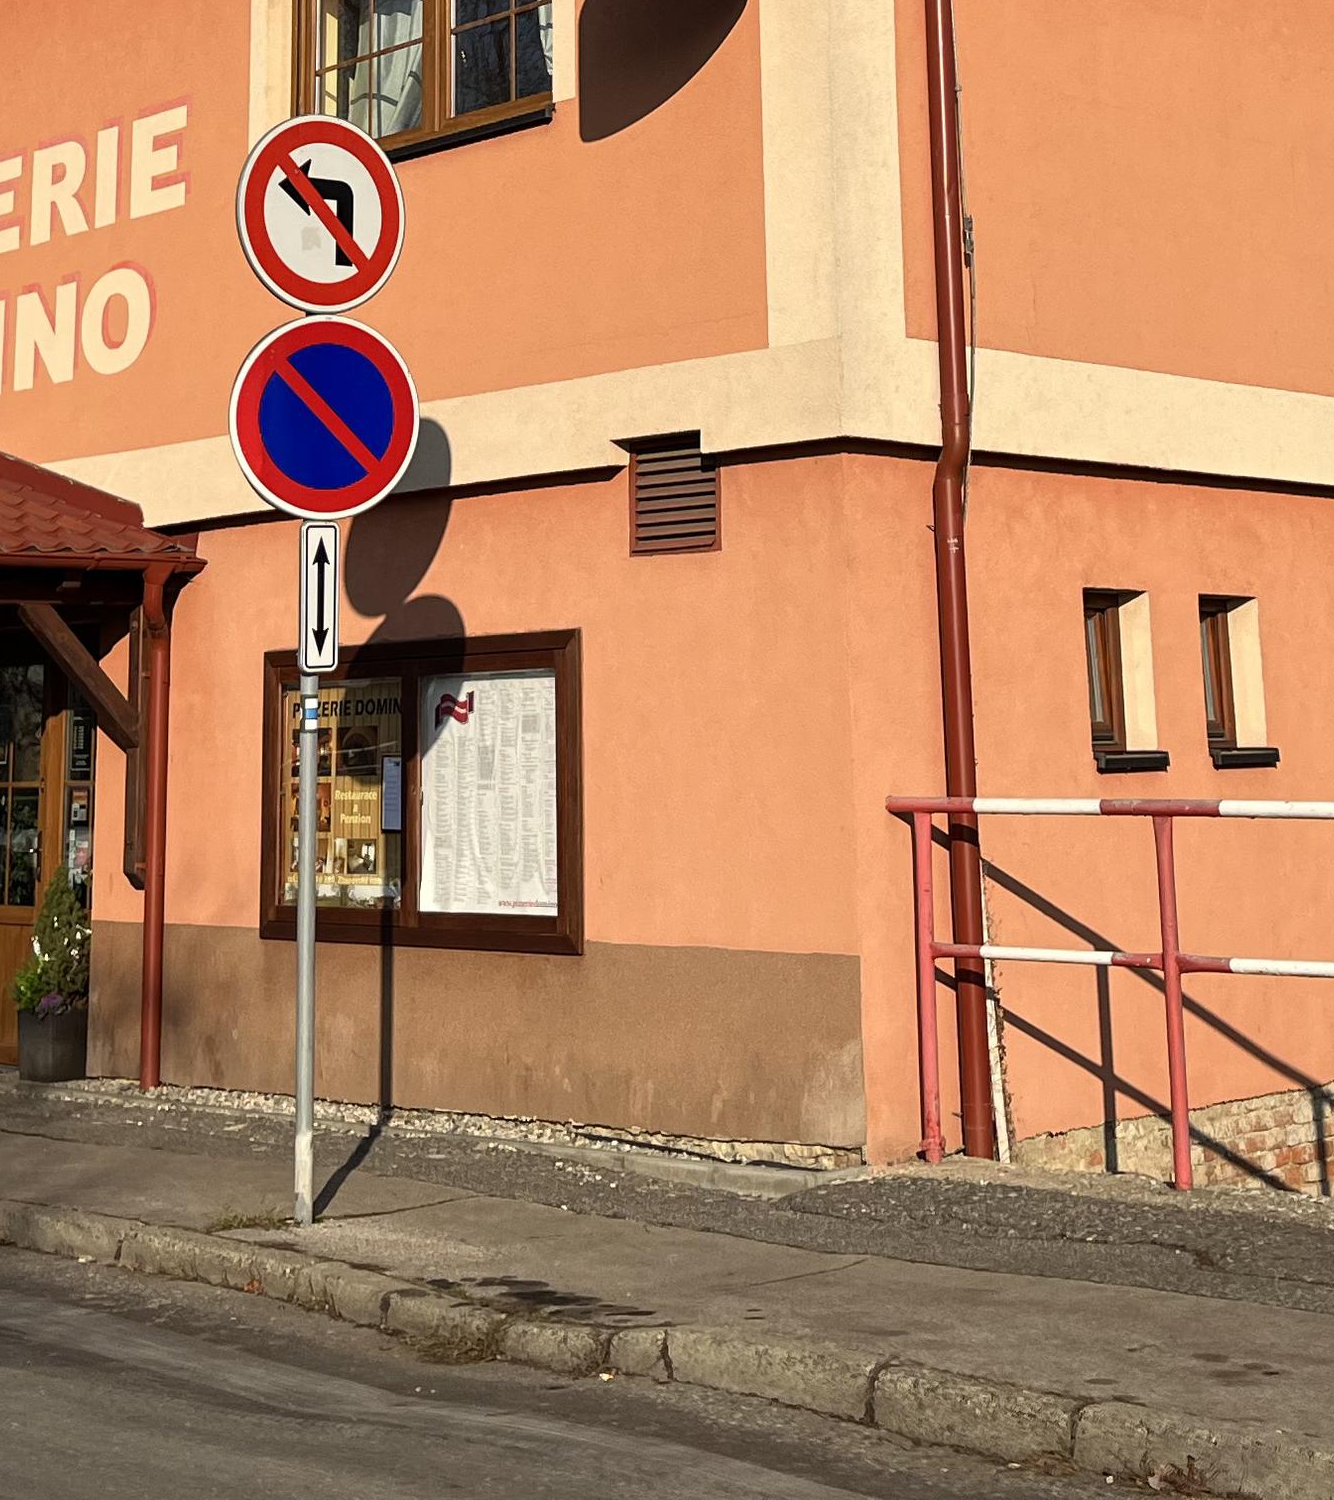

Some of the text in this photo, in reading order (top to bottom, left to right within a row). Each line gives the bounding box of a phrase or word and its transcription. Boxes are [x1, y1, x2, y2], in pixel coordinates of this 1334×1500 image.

[293, 698, 402, 718] PERIE DOMIN
[334, 790, 377, 800] Restaurace
